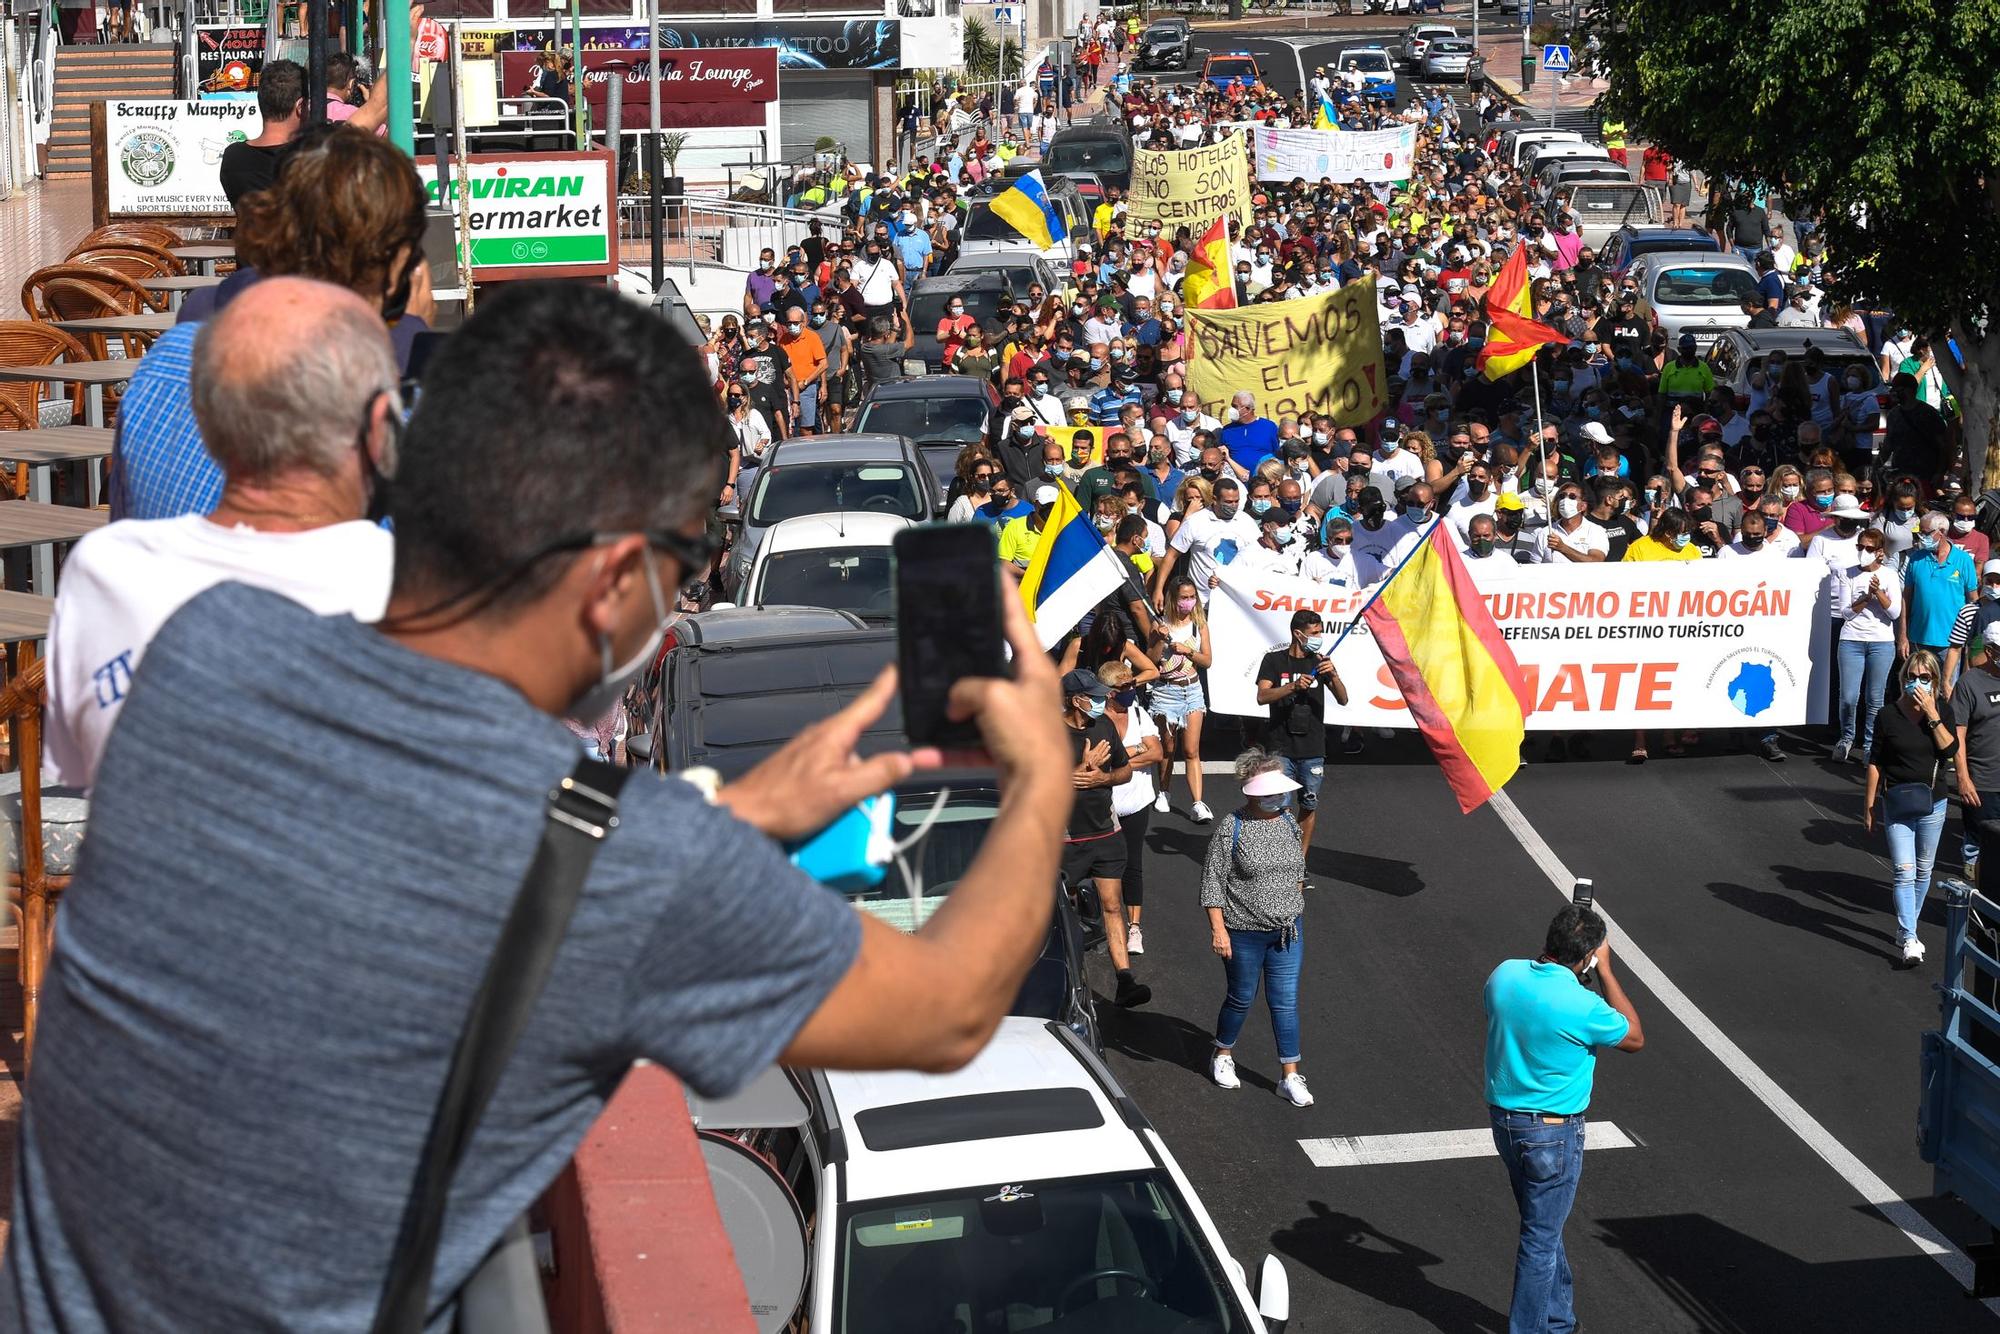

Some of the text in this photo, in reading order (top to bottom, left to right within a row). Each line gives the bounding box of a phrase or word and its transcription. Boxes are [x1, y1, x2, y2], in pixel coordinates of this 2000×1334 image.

[764, 36, 850, 53] TATTOO
[690, 61, 752, 87] Lounge
[117, 102, 257, 120] Scruffy Murphy's
[1144, 154, 1169, 176] LOS
[1178, 140, 1238, 172] HOTELES
[1146, 179, 1170, 200] NO
[1194, 163, 1234, 195] SON
[136, 204, 172, 212] SPORTS
[173, 204, 190, 212] LIVE
[191, 204, 212, 212] NOT
[137, 195, 155, 203] LIVE
[155, 195, 184, 203] MUSIC
[185, 195, 212, 203] EVERY
[1157, 189, 1237, 218] CENTROS
[454, 203, 602, 232] ermarket
[1614, 326, 1640, 338] FILA
[1261, 363, 1308, 392] EL
[1629, 591, 1670, 618] EN
[1677, 581, 1791, 618] MOGÁN
[1564, 626, 1593, 640] DEL
[1597, 625, 1664, 639] DESTINO
[1668, 621, 1745, 639] TURÍSTICO
